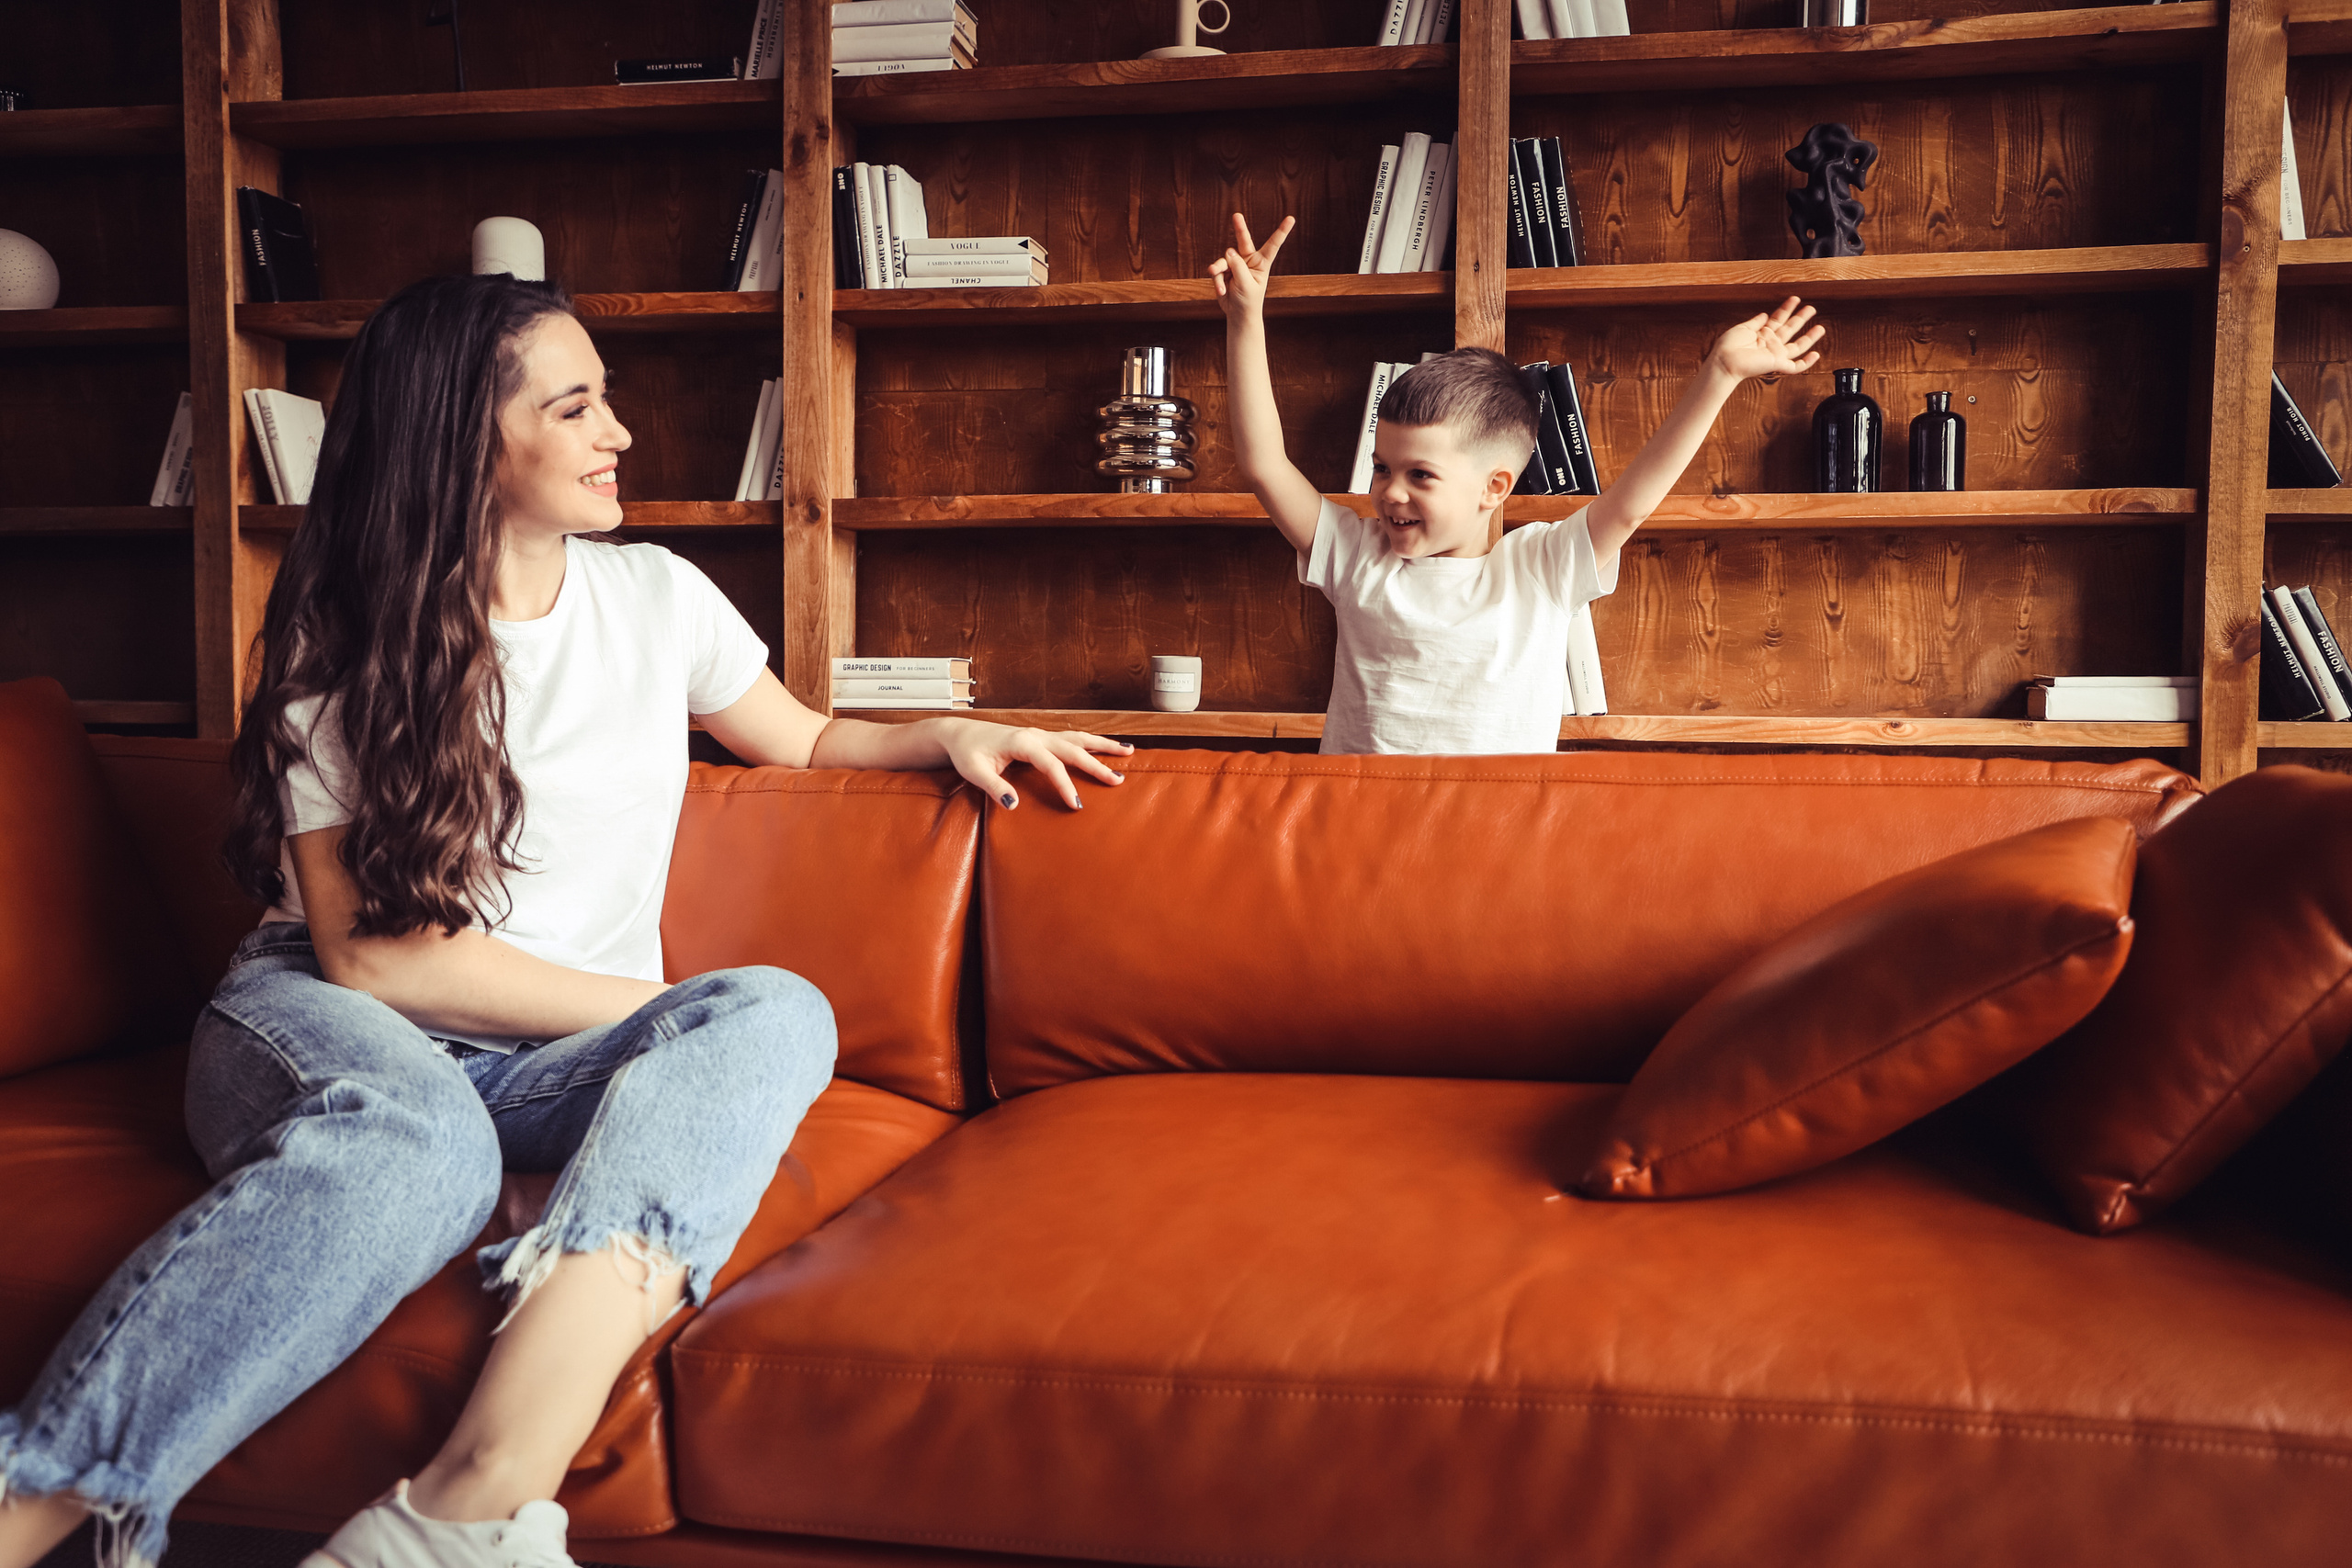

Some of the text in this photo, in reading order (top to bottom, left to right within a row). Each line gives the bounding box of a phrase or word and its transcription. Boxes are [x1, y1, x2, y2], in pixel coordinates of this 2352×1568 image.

[751, 40, 764, 78] MARIELLE
[758, 17, 768, 39] PRICE
[837, 172, 846, 190] ONE
[1376, 161, 1389, 190] GRAPHIC
[1372, 191, 1384, 216] DESIGN
[1411, 170, 1436, 250] PETER LINDBERGH
[1509, 174, 1524, 237] HELMUT NEWTON
[1532, 181, 1546, 224] FASHION
[1555, 186, 1569, 229] FASHION
[252, 229, 266, 265] FASHION
[729, 203, 748, 261] HELMUT NEWTON
[876, 224, 885, 245] DALE
[1363, 231, 1374, 263] BEGINNERS
[877, 246, 888, 283] MICHAEL
[892, 235, 902, 277] DAZZLE
[1367, 374, 1386, 434] MICHAEL DALE
[2286, 406, 2300, 423] NOIR
[262, 405, 279, 441] JOLLY
[1566, 412, 1583, 456] FASHION
[2297, 423, 2311, 442] PINOT
[774, 446, 784, 489] DAZZ
[1555, 467, 1566, 486] ONE
[2267, 615, 2301, 679] HELMUT NEWTON
[2317, 630, 2344, 673] FASHION
[842, 663, 868, 671] GRAPHIC
[2322, 685, 2332, 700] STUDIO
